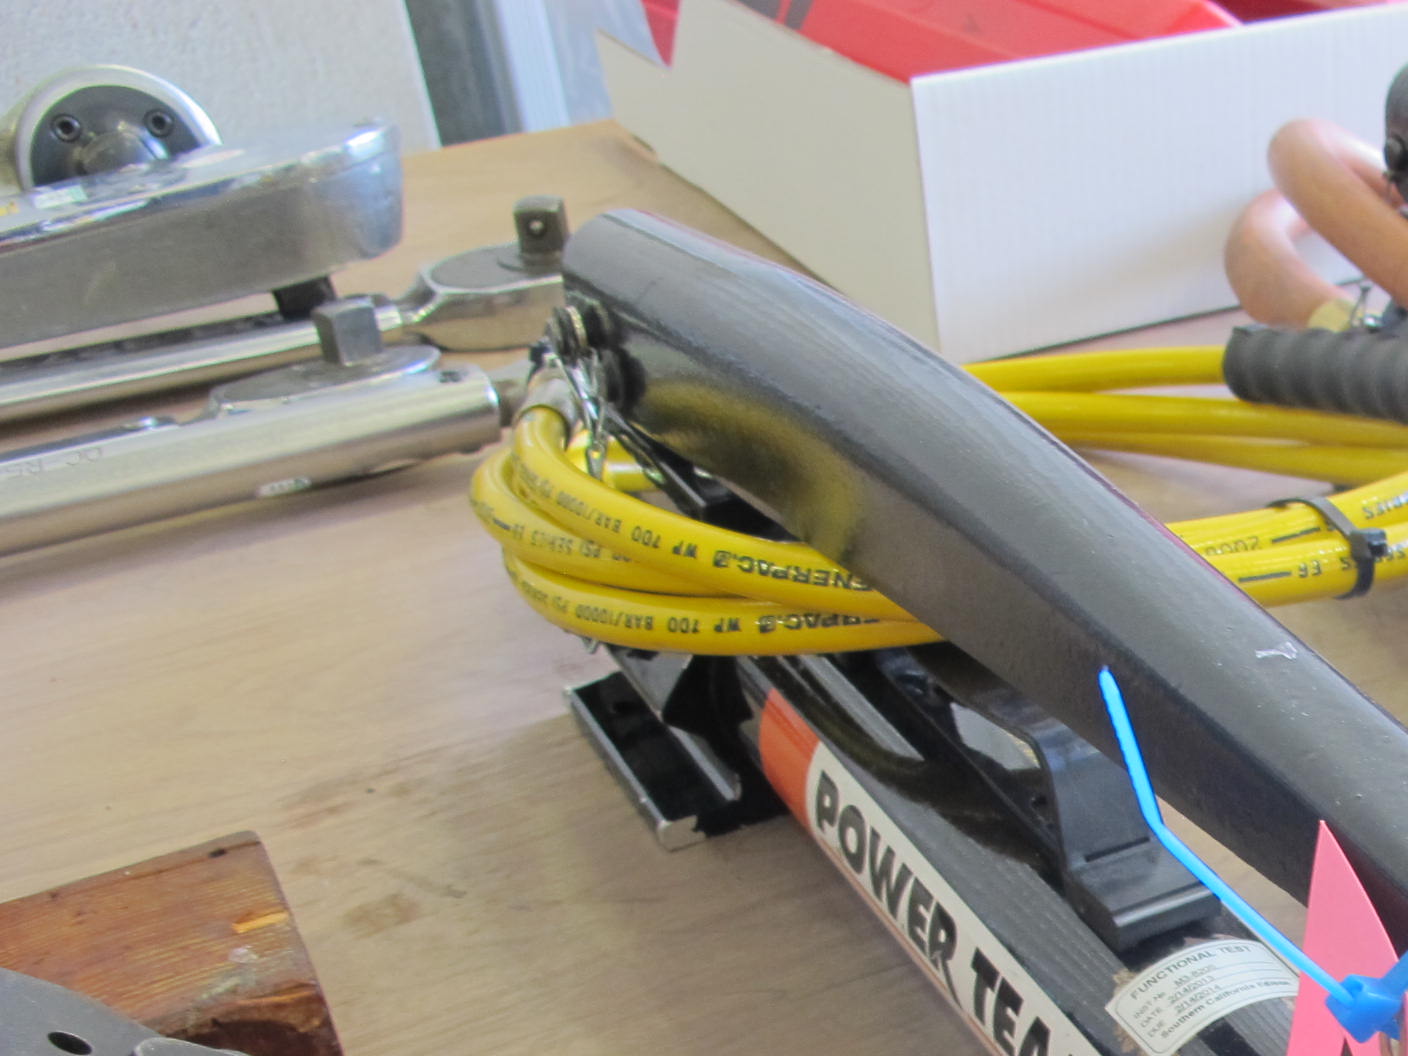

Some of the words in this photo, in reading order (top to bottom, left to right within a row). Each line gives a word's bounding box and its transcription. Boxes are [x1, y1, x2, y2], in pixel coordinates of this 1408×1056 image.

[631, 525, 672, 549] 700
[671, 540, 699, 559] WP
[667, 616, 700, 634] 700
[713, 617, 742, 633] WP
[814, 770, 963, 1011] POWER
[1130, 951, 1217, 1001] FUNCTIONAL
[1218, 943, 1252, 959] TEST
[1160, 1002, 1206, 1040] Southern
[1205, 981, 1257, 1006] California
